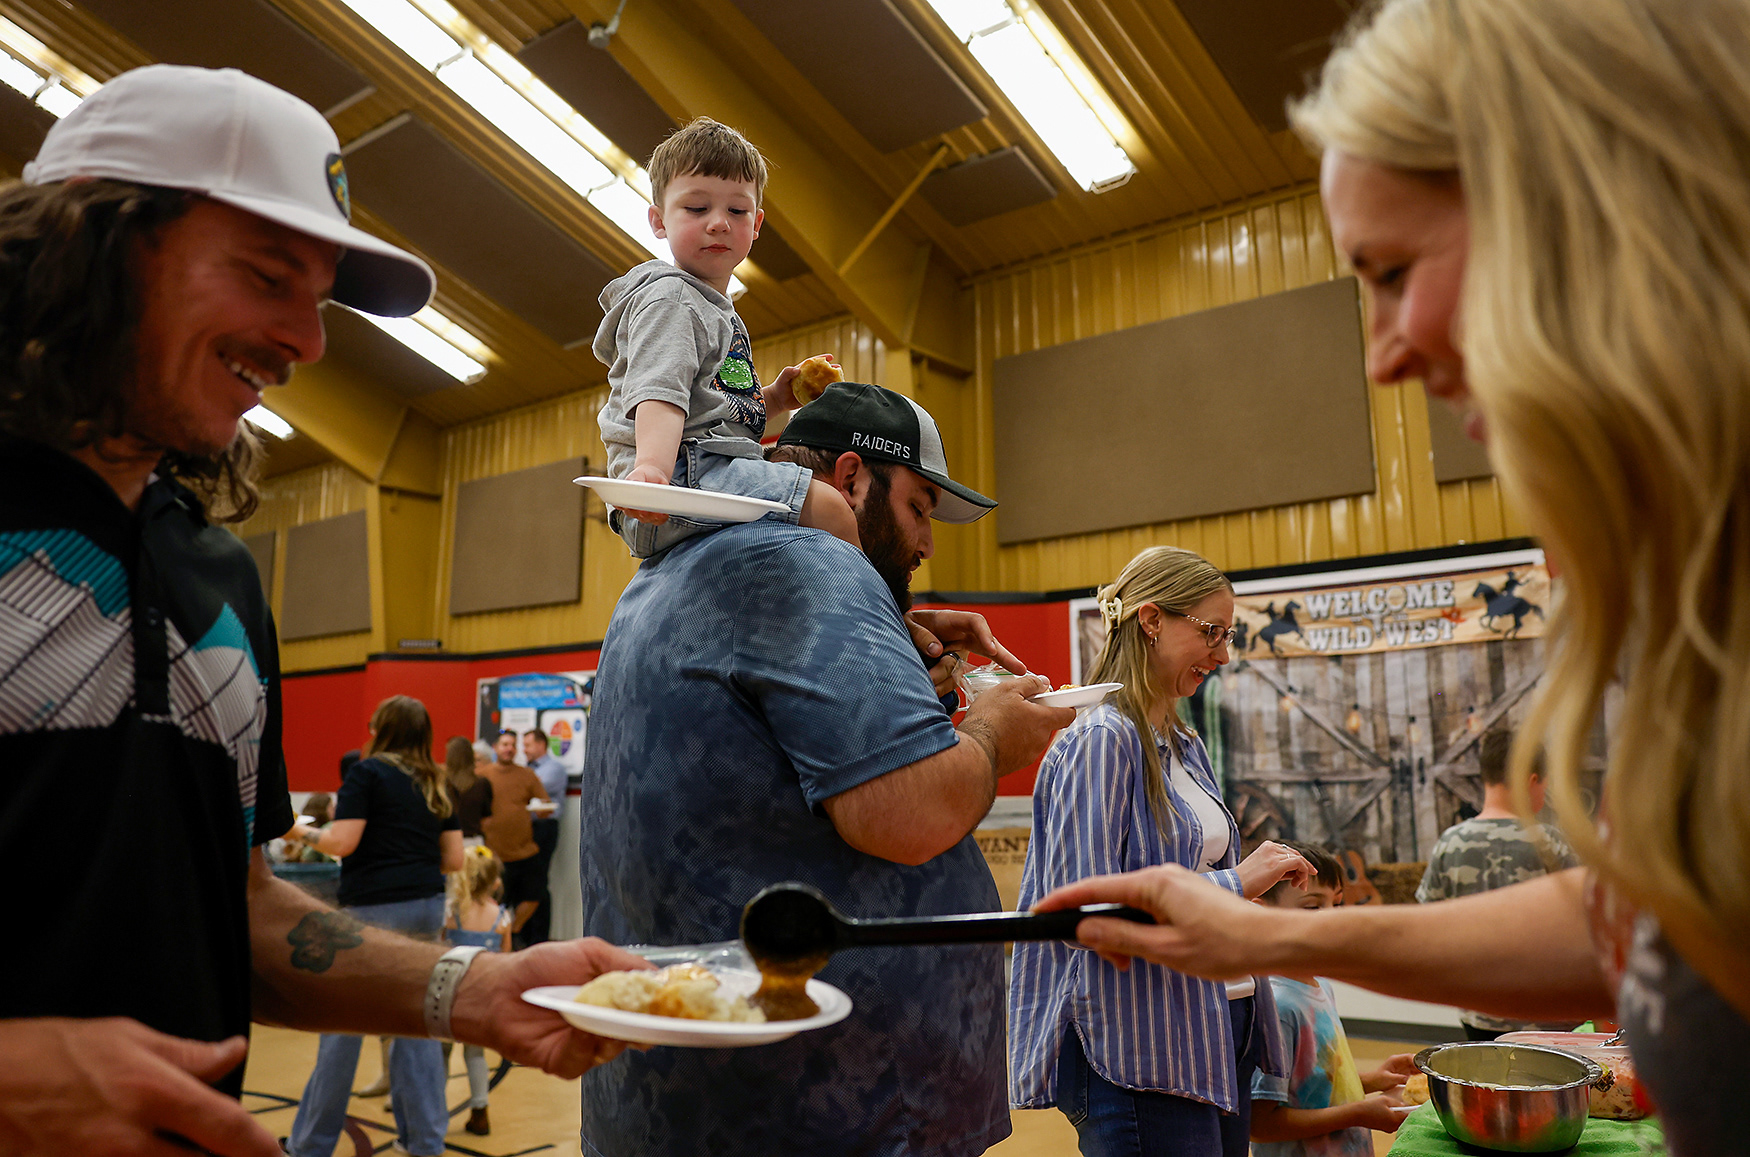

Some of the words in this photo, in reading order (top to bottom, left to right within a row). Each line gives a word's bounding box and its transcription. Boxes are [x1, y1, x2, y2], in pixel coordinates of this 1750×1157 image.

[851, 431, 911, 459] RAIDERS
[1305, 580, 1455, 620] WELCOME
[1308, 626, 1374, 651] WILD
[1384, 617, 1455, 646] WEST
